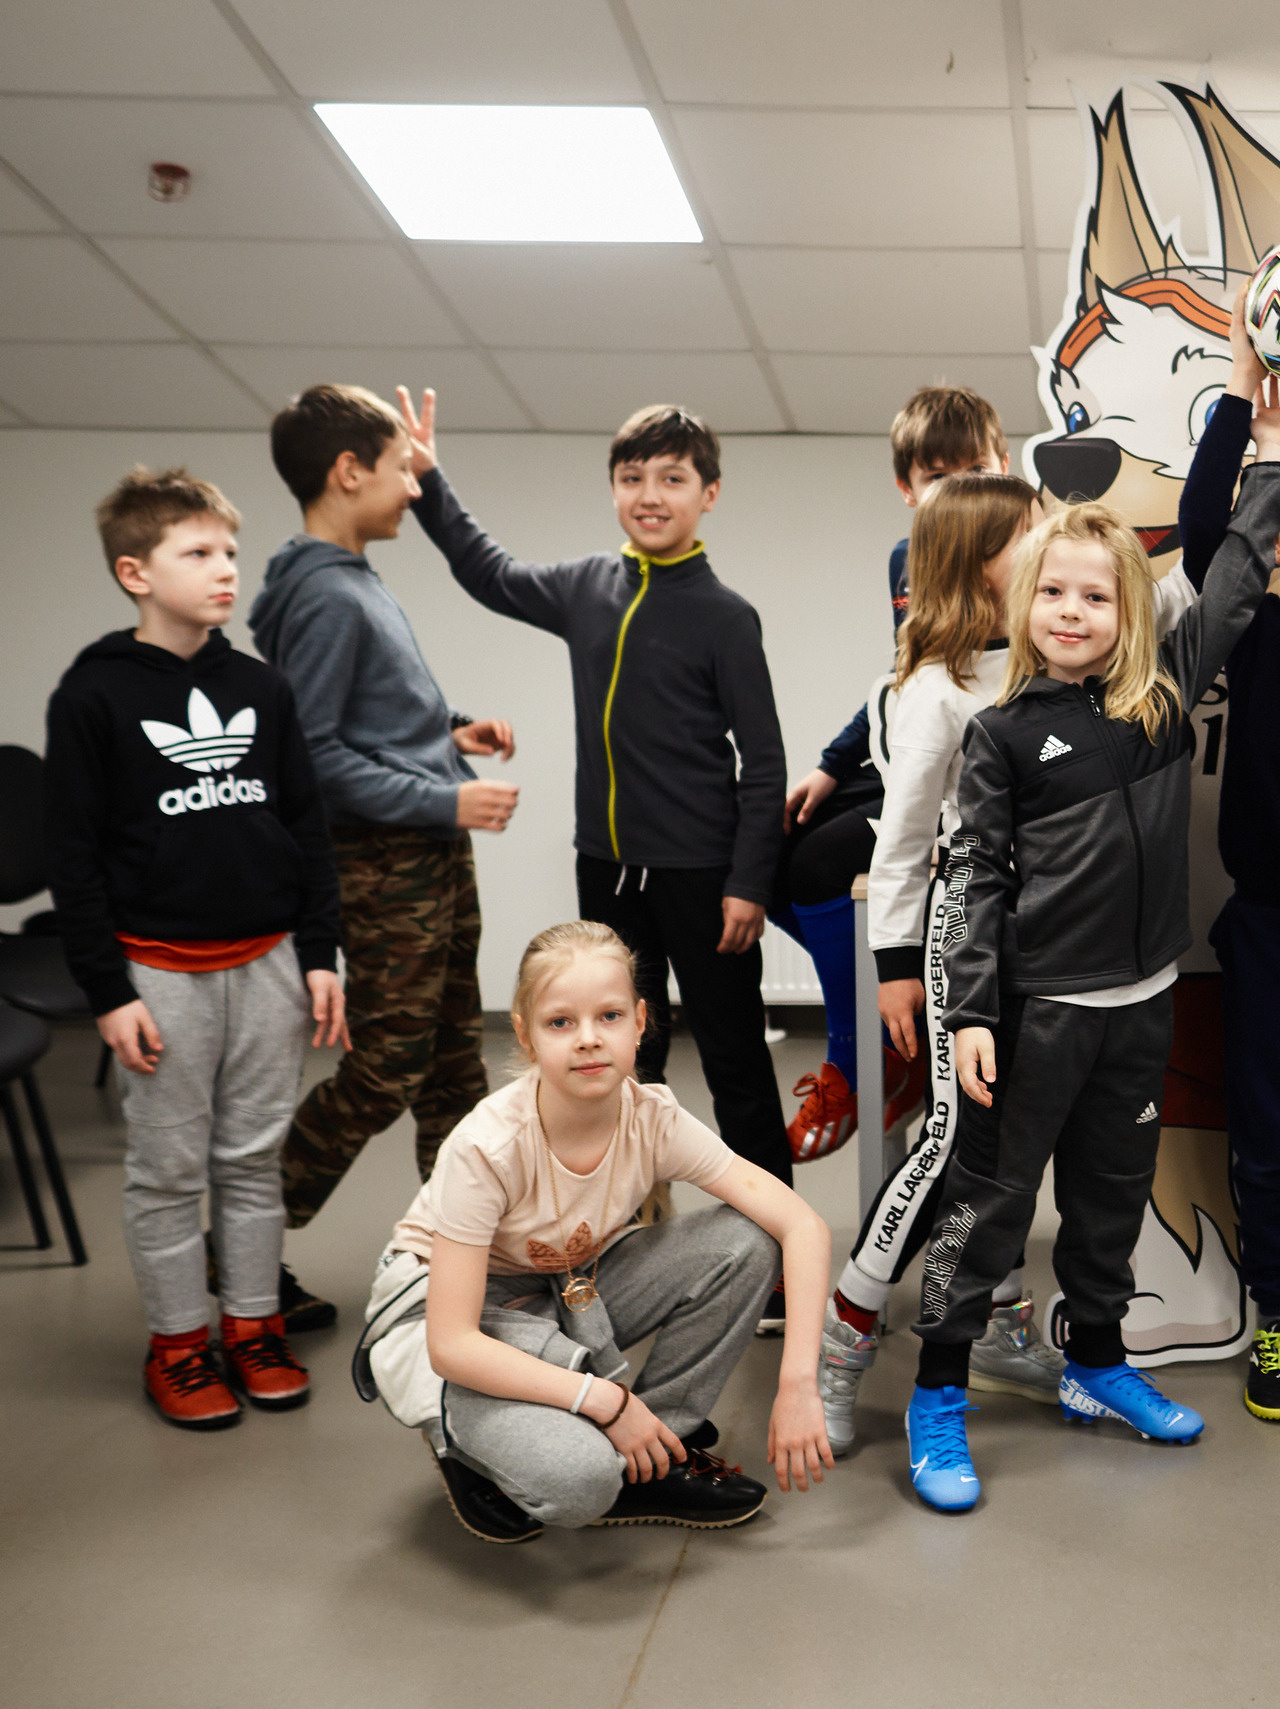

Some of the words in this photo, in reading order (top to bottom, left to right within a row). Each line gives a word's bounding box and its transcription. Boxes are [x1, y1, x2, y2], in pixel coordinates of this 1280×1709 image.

[1038, 744, 1073, 762] adidas
[158, 773, 267, 816] adidas
[936, 1030, 951, 1081] KARL
[1135, 1111, 1158, 1124] adidas
[874, 1205, 909, 1253] KARL
